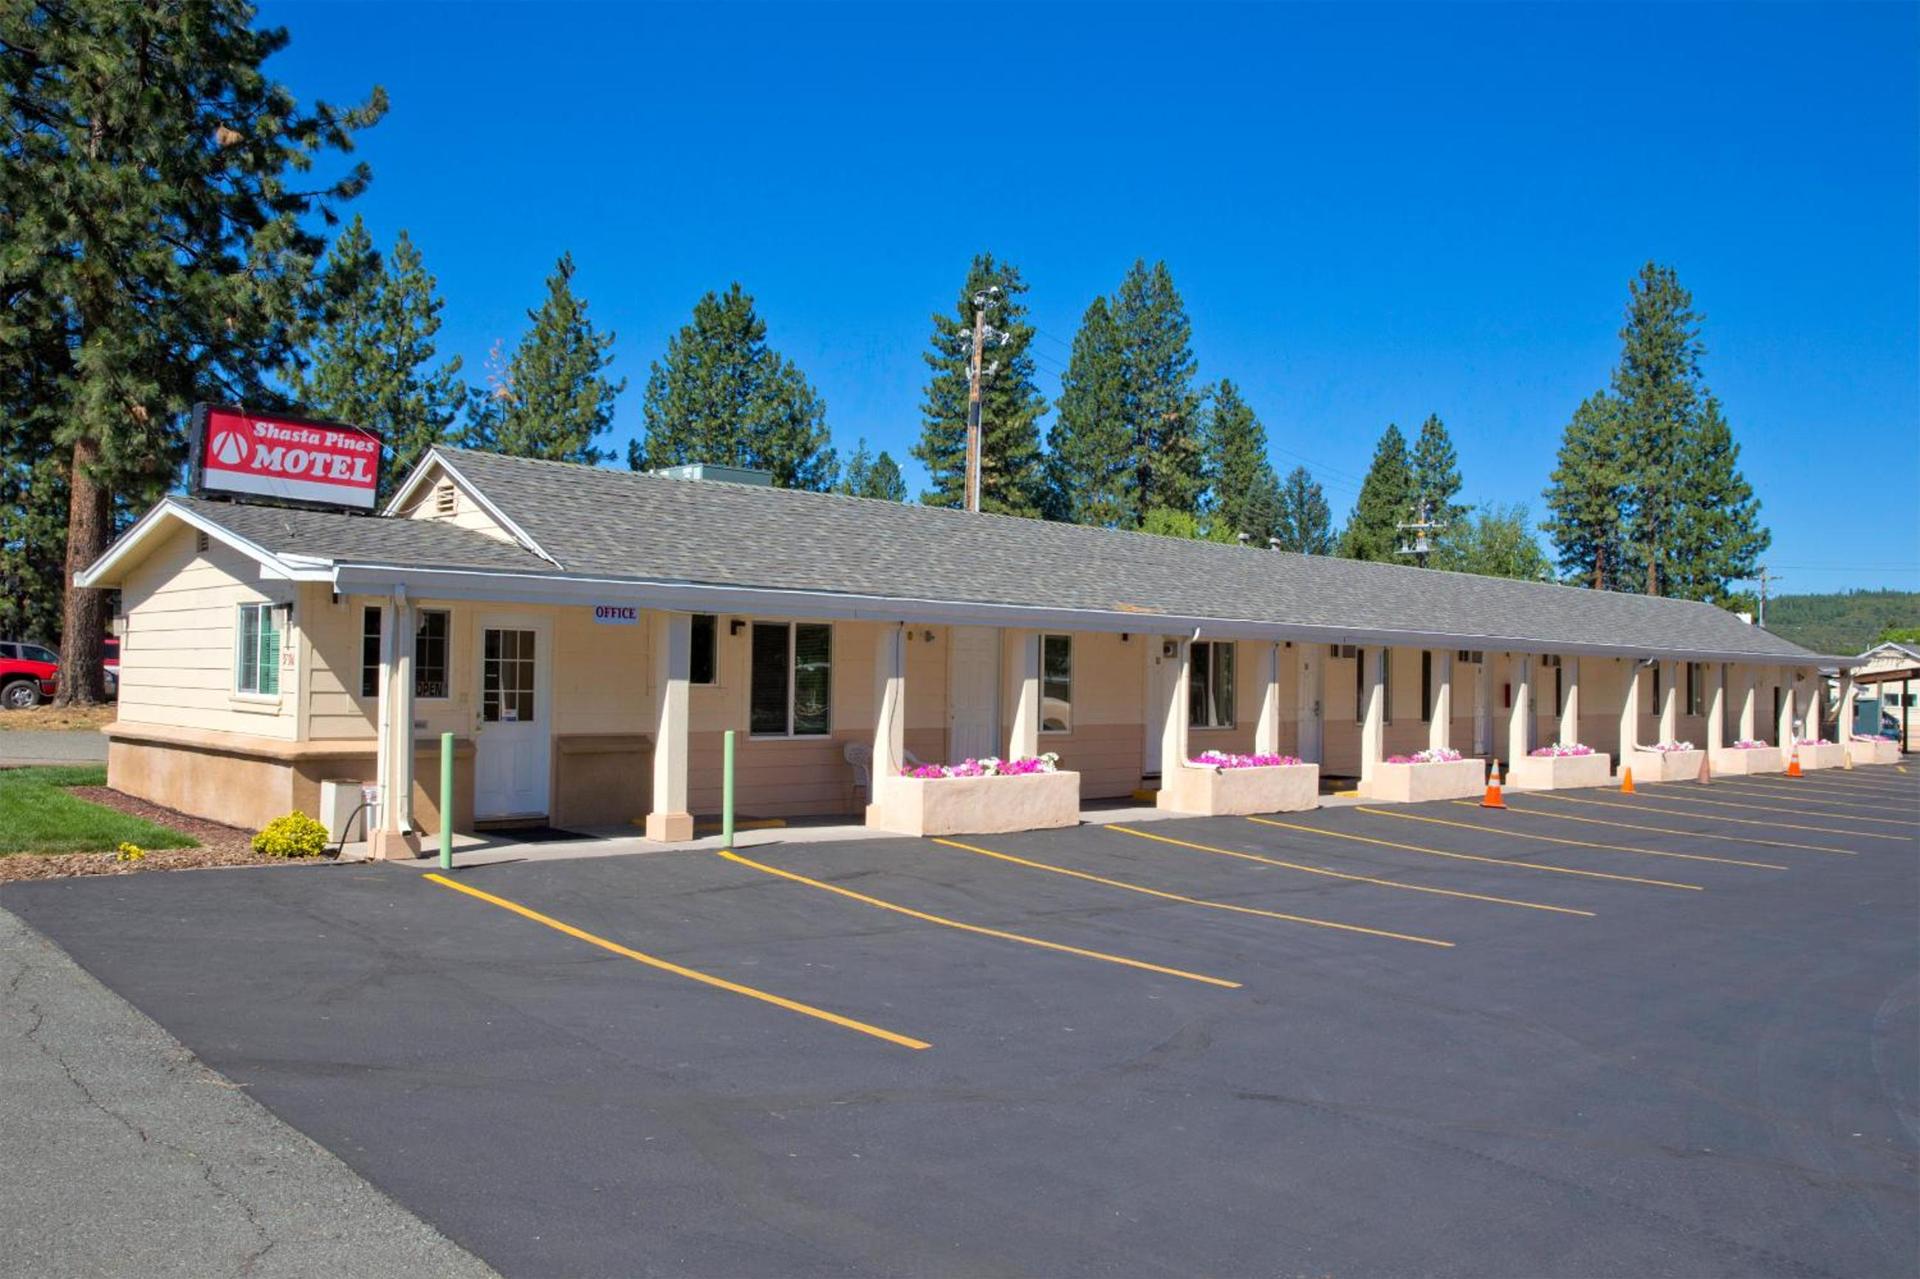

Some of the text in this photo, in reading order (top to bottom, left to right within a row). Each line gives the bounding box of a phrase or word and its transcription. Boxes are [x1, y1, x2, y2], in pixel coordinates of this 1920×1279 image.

[253, 422, 375, 453] Shasta Pines
[251, 445, 372, 483] MOTEL
[595, 606, 637, 619] OFFICE
[416, 682, 442, 696] OPEN
